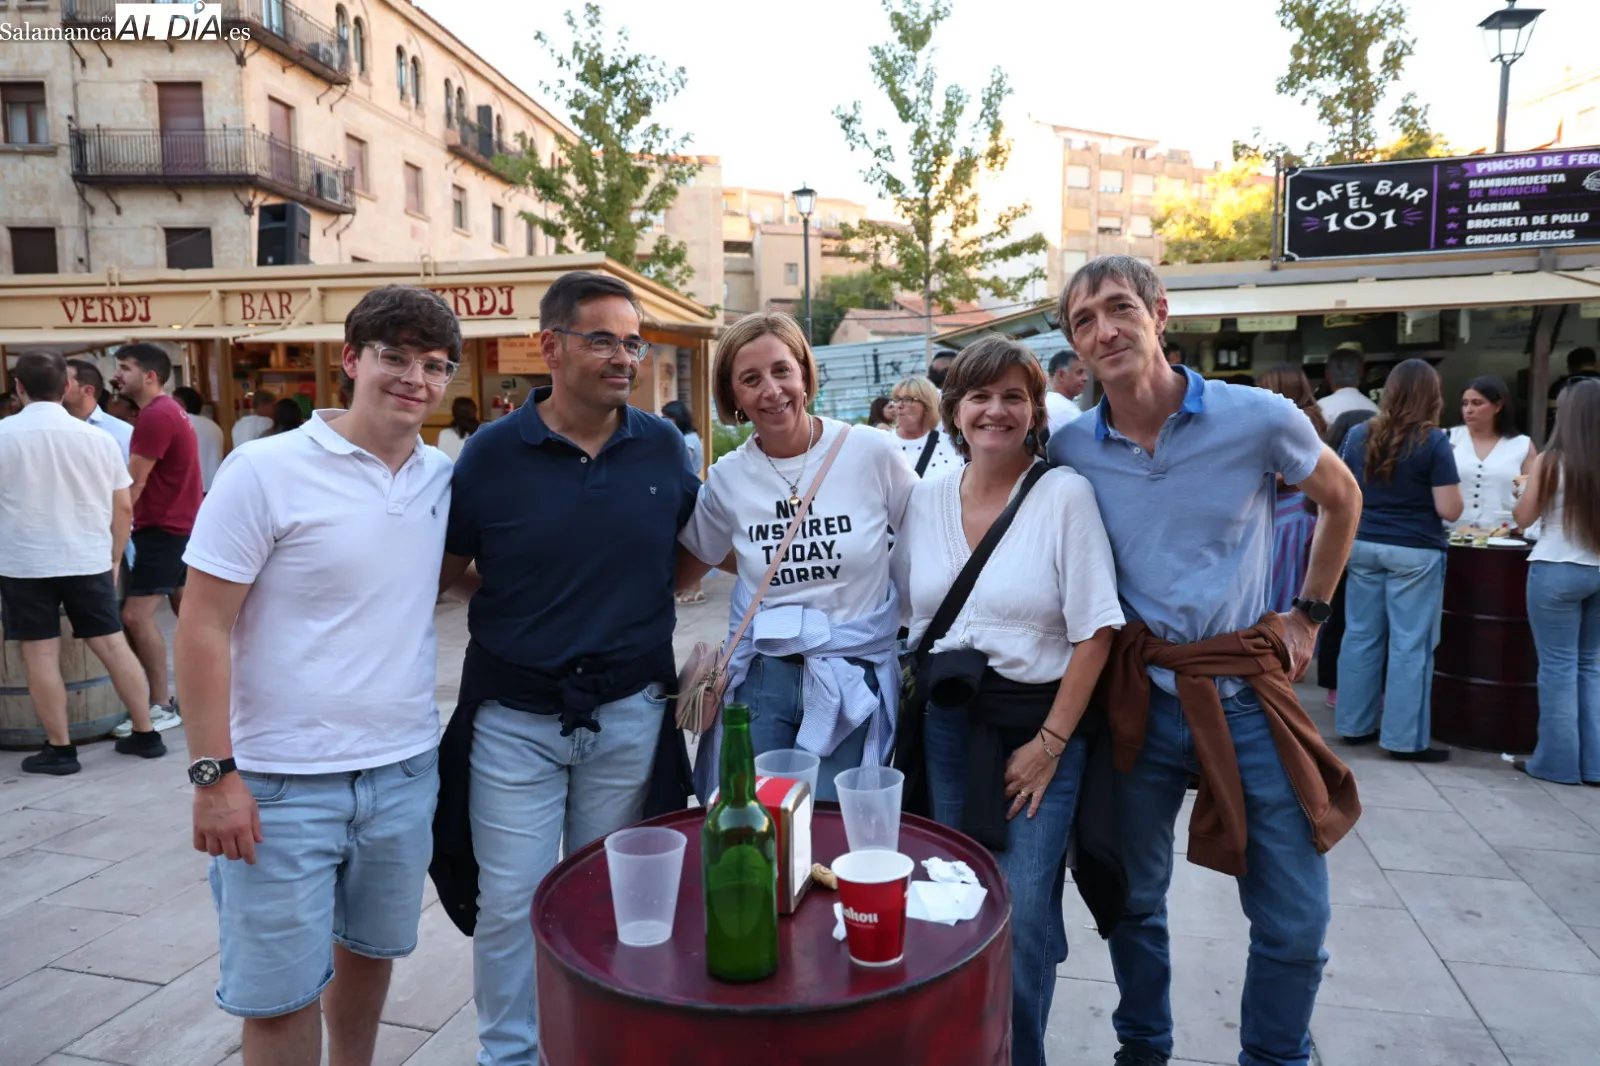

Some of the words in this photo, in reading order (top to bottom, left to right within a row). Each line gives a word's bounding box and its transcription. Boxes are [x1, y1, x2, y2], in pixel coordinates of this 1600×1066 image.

[1475, 156, 1537, 173] PINCHO
[1541, 154, 1564, 167] DE
[1567, 153, 1600, 166] FER
[1468, 173, 1566, 189] HAMBURGUESITA
[1296, 181, 1361, 211] CAFE
[1374, 180, 1428, 205] BAR
[1468, 189, 1484, 198] DE
[1488, 184, 1548, 197] MORUCHA
[1348, 196, 1374, 209] EL
[1467, 201, 1520, 214] LÁGRIMA
[1323, 208, 1397, 232] 101
[1466, 216, 1528, 230] BROCHETA
[1531, 214, 1548, 225] DE
[1551, 212, 1590, 224] POLLO
[1465, 232, 1518, 245] CHICHAS
[1521, 229, 1575, 242] IBÉRICAS
[239, 291, 294, 321] BAR
[749, 514, 852, 542] INSIRED
[769, 564, 841, 587] SORRY
